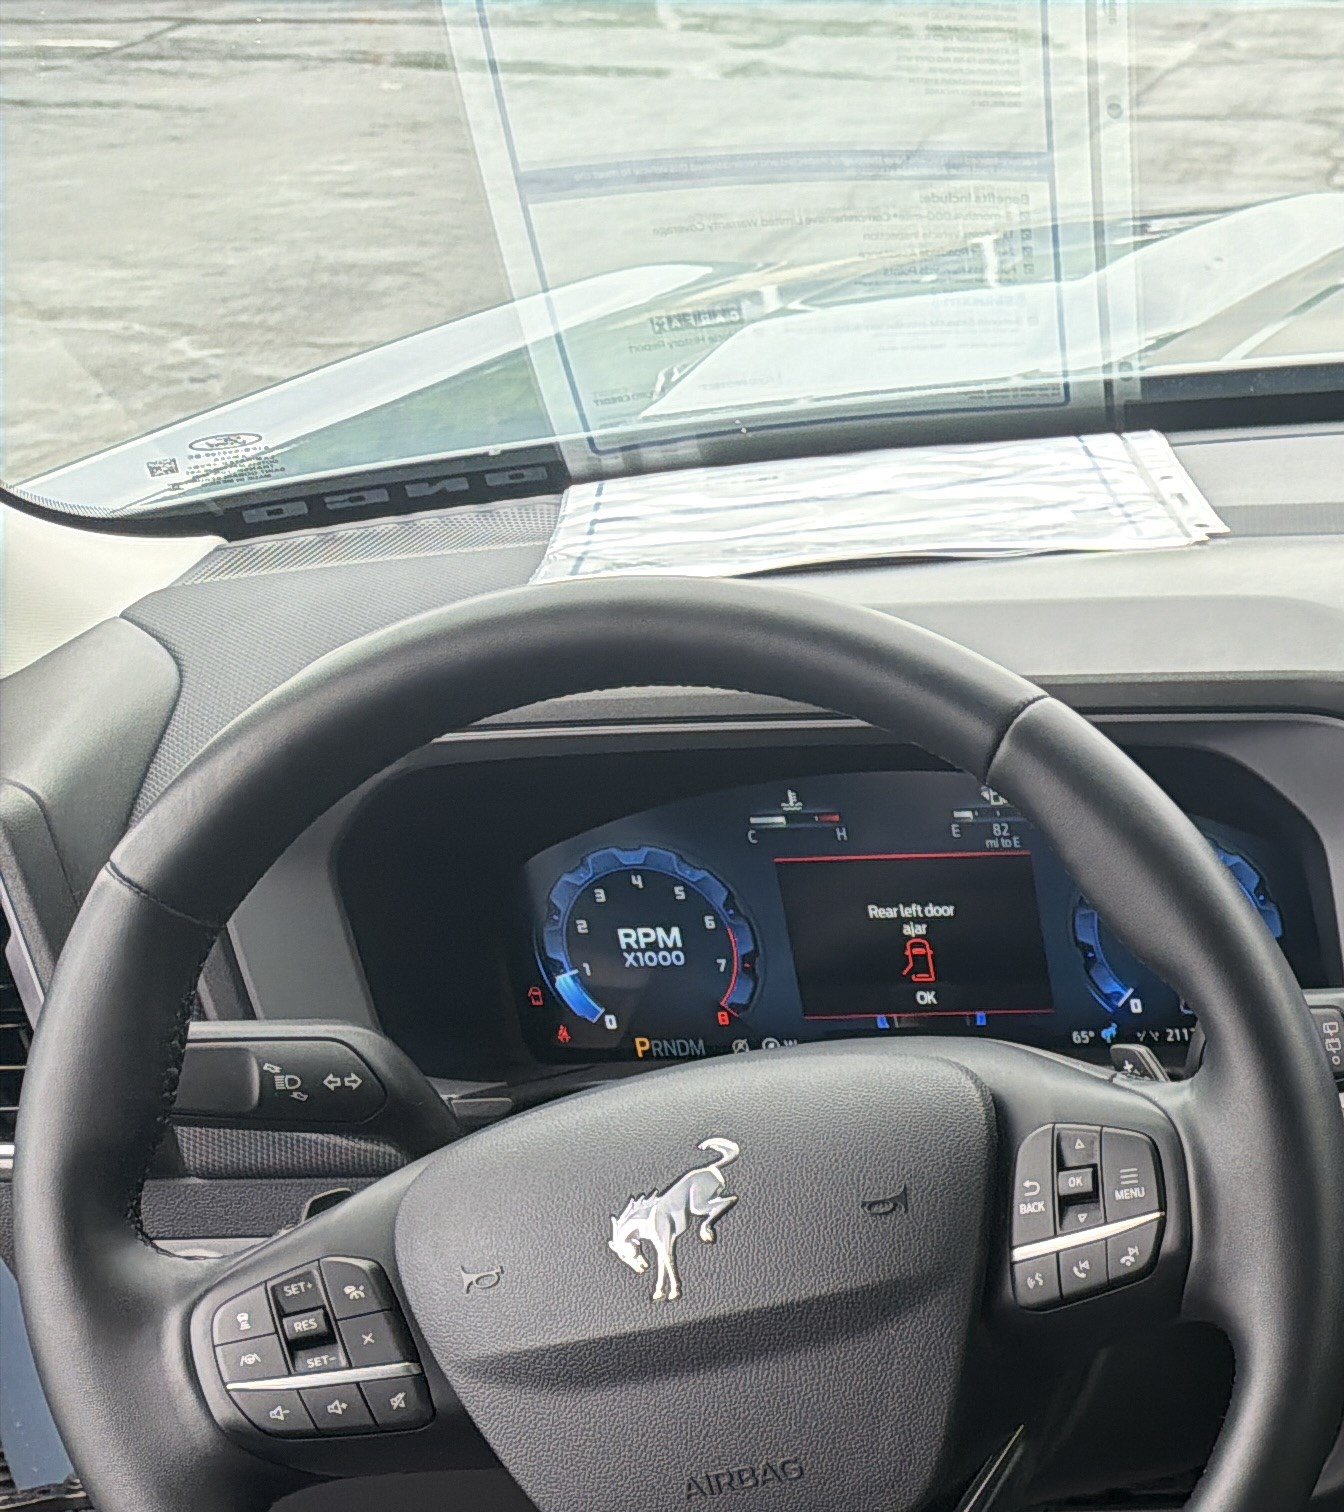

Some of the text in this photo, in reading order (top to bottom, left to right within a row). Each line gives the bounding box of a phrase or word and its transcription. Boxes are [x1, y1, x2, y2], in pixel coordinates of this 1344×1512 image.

[748, 828, 759, 845] C
[835, 826, 848, 842] H
[951, 824, 961, 839] E
[992, 822, 1011, 837] 82
[1000, 837, 1012, 849] to
[1013, 837, 1022, 849] E
[631, 874, 645, 889] 4
[594, 888, 607, 903] 3
[674, 886, 686, 900] 5
[867, 902, 955, 920] Rear left door
[575, 920, 589, 934] 2
[703, 915, 717, 930] 6
[903, 920, 928, 938] ajar
[617, 926, 683, 950] RPM
[622, 950, 686, 968] X1000
[716, 958, 727, 973] 7
[582, 962, 592, 977] 1
[915, 991, 938, 1006] OK
[1129, 997, 1144, 1014] 0
[604, 1014, 618, 1030] 0
[717, 1010, 730, 1026] 8
[1071, 1029, 1096, 1045] 65°
[1068, 1175, 1083, 1189] OK
[1114, 1186, 1146, 1201] MENU
[1019, 1200, 1046, 1215] BACK
[282, 1280, 315, 1299] SET+
[293, 1317, 318, 1334] RES
[685, 1455, 804, 1500] AIRBAG
